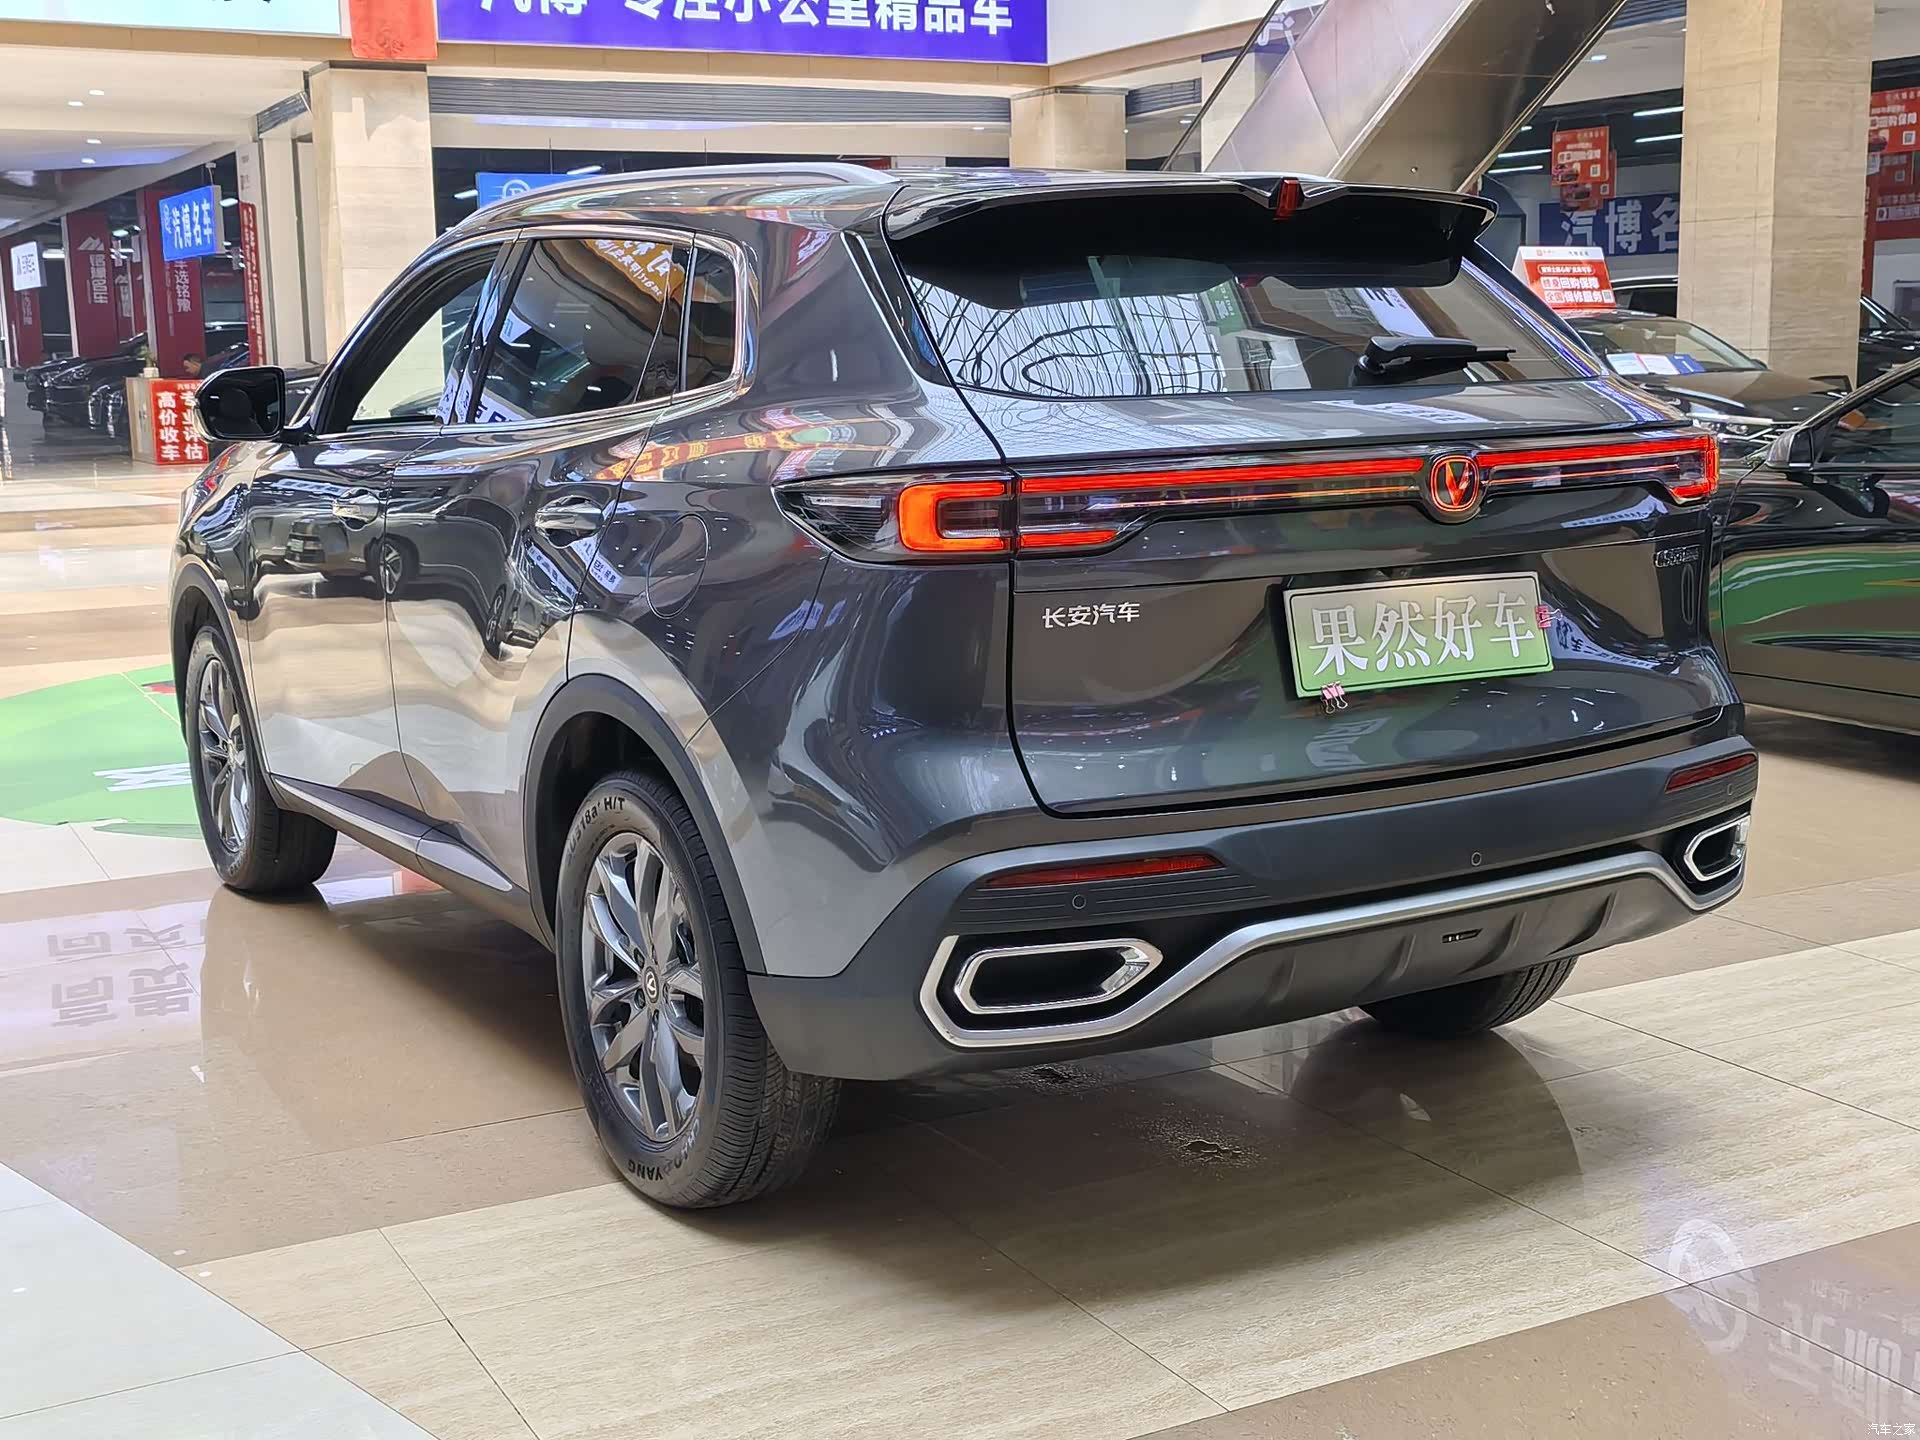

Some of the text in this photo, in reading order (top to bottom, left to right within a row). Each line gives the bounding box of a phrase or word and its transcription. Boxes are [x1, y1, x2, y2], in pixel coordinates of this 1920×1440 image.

[172, 198, 213, 249] 汽博名车
[157, 391, 180, 460] 高价收车
[1042, 602, 1140, 628] 长安汽车
[1308, 591, 1536, 677] 果然好车
[604, 796, 625, 811] H/T
